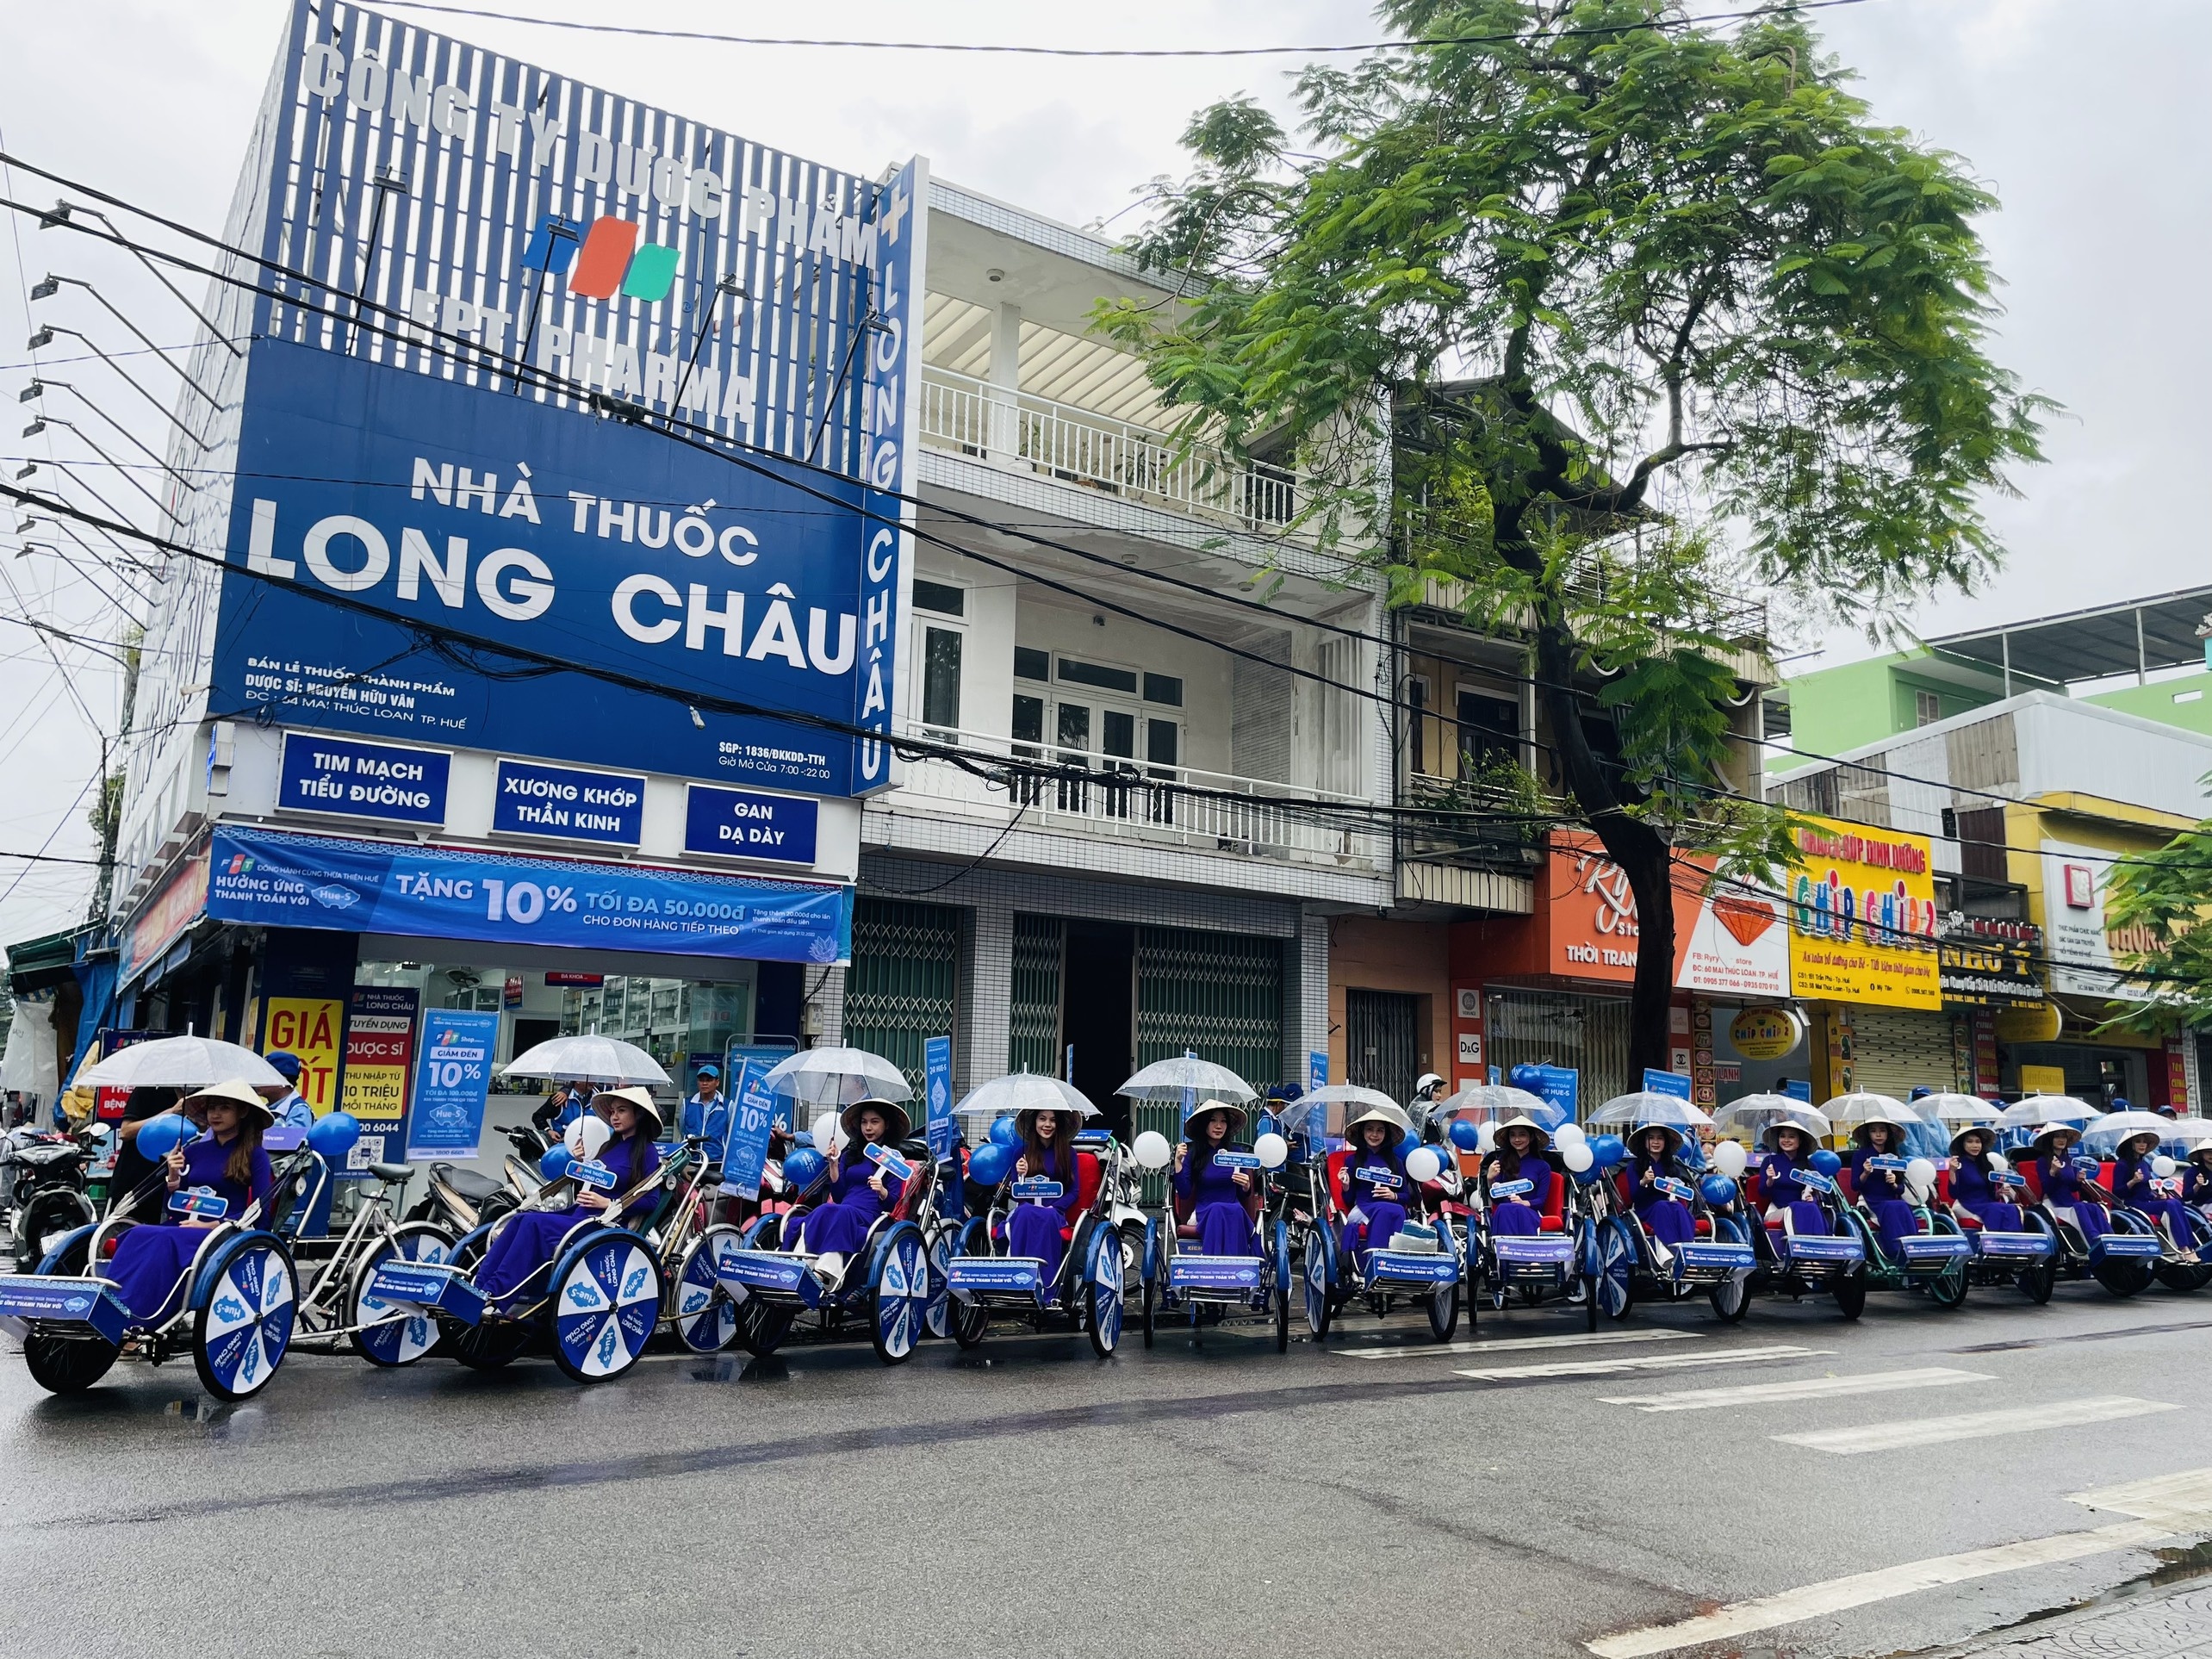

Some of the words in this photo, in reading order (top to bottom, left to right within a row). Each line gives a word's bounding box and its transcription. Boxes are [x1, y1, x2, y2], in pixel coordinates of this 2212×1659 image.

[303, 42, 470, 140] CÔNG
[493, 101, 562, 166] TY
[576, 130, 723, 218] DƯỢC
[747, 185, 877, 270] PHẨM
[408, 288, 513, 357] FPT
[537, 322, 754, 425] PHARMA
[871, 261, 902, 495] LONG
[410, 457, 542, 525] NHÀ
[568, 490, 759, 566] THUỐC
[246, 498, 556, 621] LONG
[611, 573, 857, 675] CHÂU
[861, 528, 893, 780] CHÂU
[247, 656, 280, 671] BÁN
[285, 661, 300, 674] LẺ
[304, 666, 356, 681] THUỐC
[360, 673, 411, 690] THÀNH
[413, 681, 455, 697] PHẨM
[245, 674, 282, 691] DƯỢC
[307, 682, 356, 701] NGUYỄN
[360, 689, 387, 705] HỮU
[390, 693, 415, 709] VÂN
[334, 700, 370, 717] THÚC
[374, 708, 413, 722] LOAN
[440, 717, 467, 730] HUẾ
[718, 741, 743, 755] SGP:
[314, 753, 350, 773] TIM
[356, 758, 423, 781] MẠCH
[718, 756, 736, 767] Giờ
[738, 758, 754, 769] Mở
[755, 761, 777, 773] Cửa
[780, 764, 798, 775] 7:00
[300, 774, 343, 799] TIỂU
[350, 785, 431, 809] ĐƯỜNG
[504, 777, 578, 802] XƯƠNG
[583, 788, 637, 808] KHỚP
[517, 802, 569, 827] THẦN
[575, 812, 621, 832] KINH
[734, 803, 773, 821] GAN
[719, 825, 745, 845] DẠ
[749, 826, 786, 846] DÀY
[221, 856, 254, 871] FPT
[1867, 839, 1890, 867] DINH
[1892, 842, 1926, 873] DƯỠNG
[216, 875, 269, 891] HƯỞNG
[273, 878, 304, 893] ỨNG
[214, 889, 252, 902] THANH
[257, 892, 288, 904] TOÁN
[289, 895, 309, 905] VỚI
[320, 890, 351, 901] Hue-S
[395, 871, 473, 901] TẶNG
[482, 878, 578, 924] 10%
[586, 889, 622, 912] TỐI
[626, 896, 659, 914] ĐA
[663, 898, 746, 921] 50.000đ
[583, 915, 610, 927] CHO
[612, 916, 641, 929] ĐƠN
[643, 918, 678, 932] HÀNG
[680, 920, 706, 934] TIẾP
[1565, 941, 1598, 964] THỜI
[1601, 948, 1637, 966] TRAN
[1705, 954, 1719, 963] Ryry
[392, 1002, 414, 1010] CHÂU
[270, 1003, 332, 1050] GIÁ
[380, 1021, 407, 1031] DỤNG
[437, 1032, 459, 1042] FPT
[1460, 1041, 1479, 1053] D&G
[391, 1041, 405, 1055] SĨ
[438, 1048, 458, 1057] GIẢM
[461, 1049, 477, 1058] ĐẾN
[363, 1072, 387, 1082] NHẬP
[429, 1061, 482, 1088] 10%
[345, 1085, 357, 1097] 10
[362, 1084, 399, 1101] TRIỆU
[1550, 1088, 1569, 1097] HUE-S
[343, 1099, 361, 1110] MỖI
[363, 1101, 397, 1110] THÁNG
[436, 1109, 461, 1118] Hue-S
[373, 1123, 399, 1133] 6044
[740, 1106, 767, 1132] 10%
[625, 1271, 643, 1295] Hue-S
[570, 1289, 596, 1304] Hue-S
[217, 1304, 242, 1319] Hue-S
[604, 1332, 613, 1362] Hue-S
